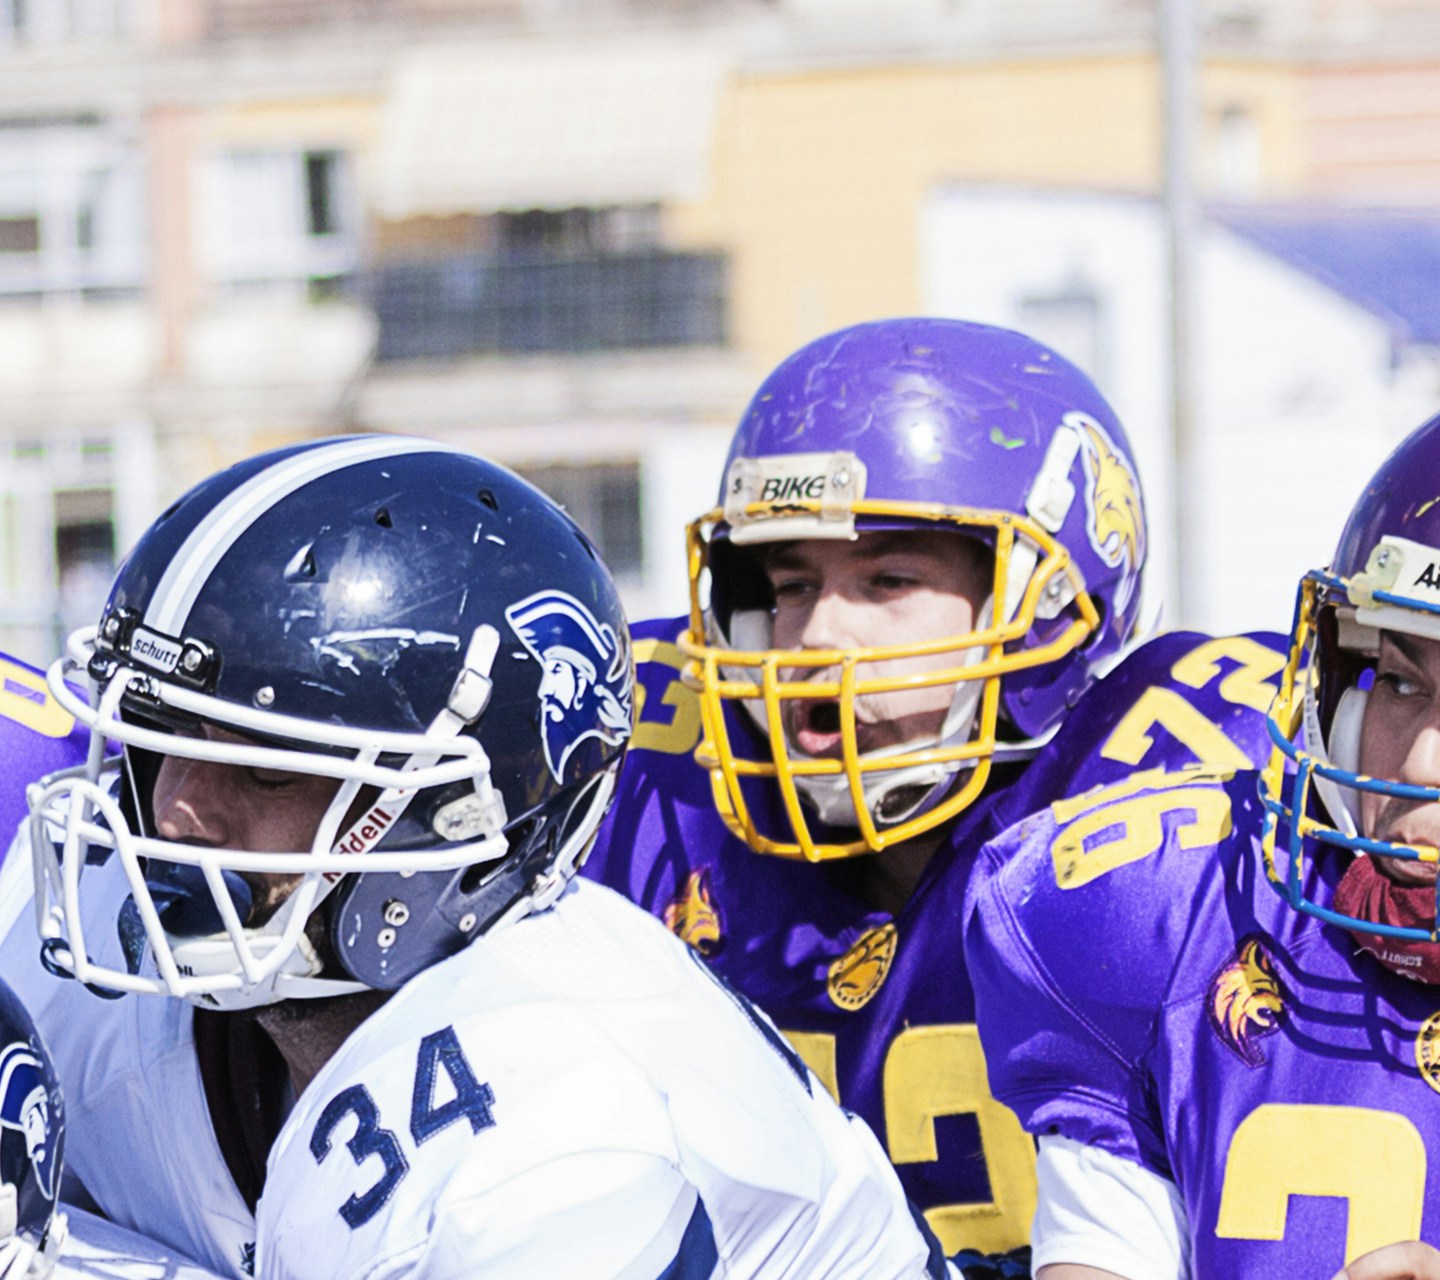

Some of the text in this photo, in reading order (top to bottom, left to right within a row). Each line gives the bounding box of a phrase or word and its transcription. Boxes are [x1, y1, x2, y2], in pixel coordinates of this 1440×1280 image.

[761, 475, 826, 501] BIKE
[133, 638, 177, 666] schutt
[309, 1024, 497, 1230] 34
